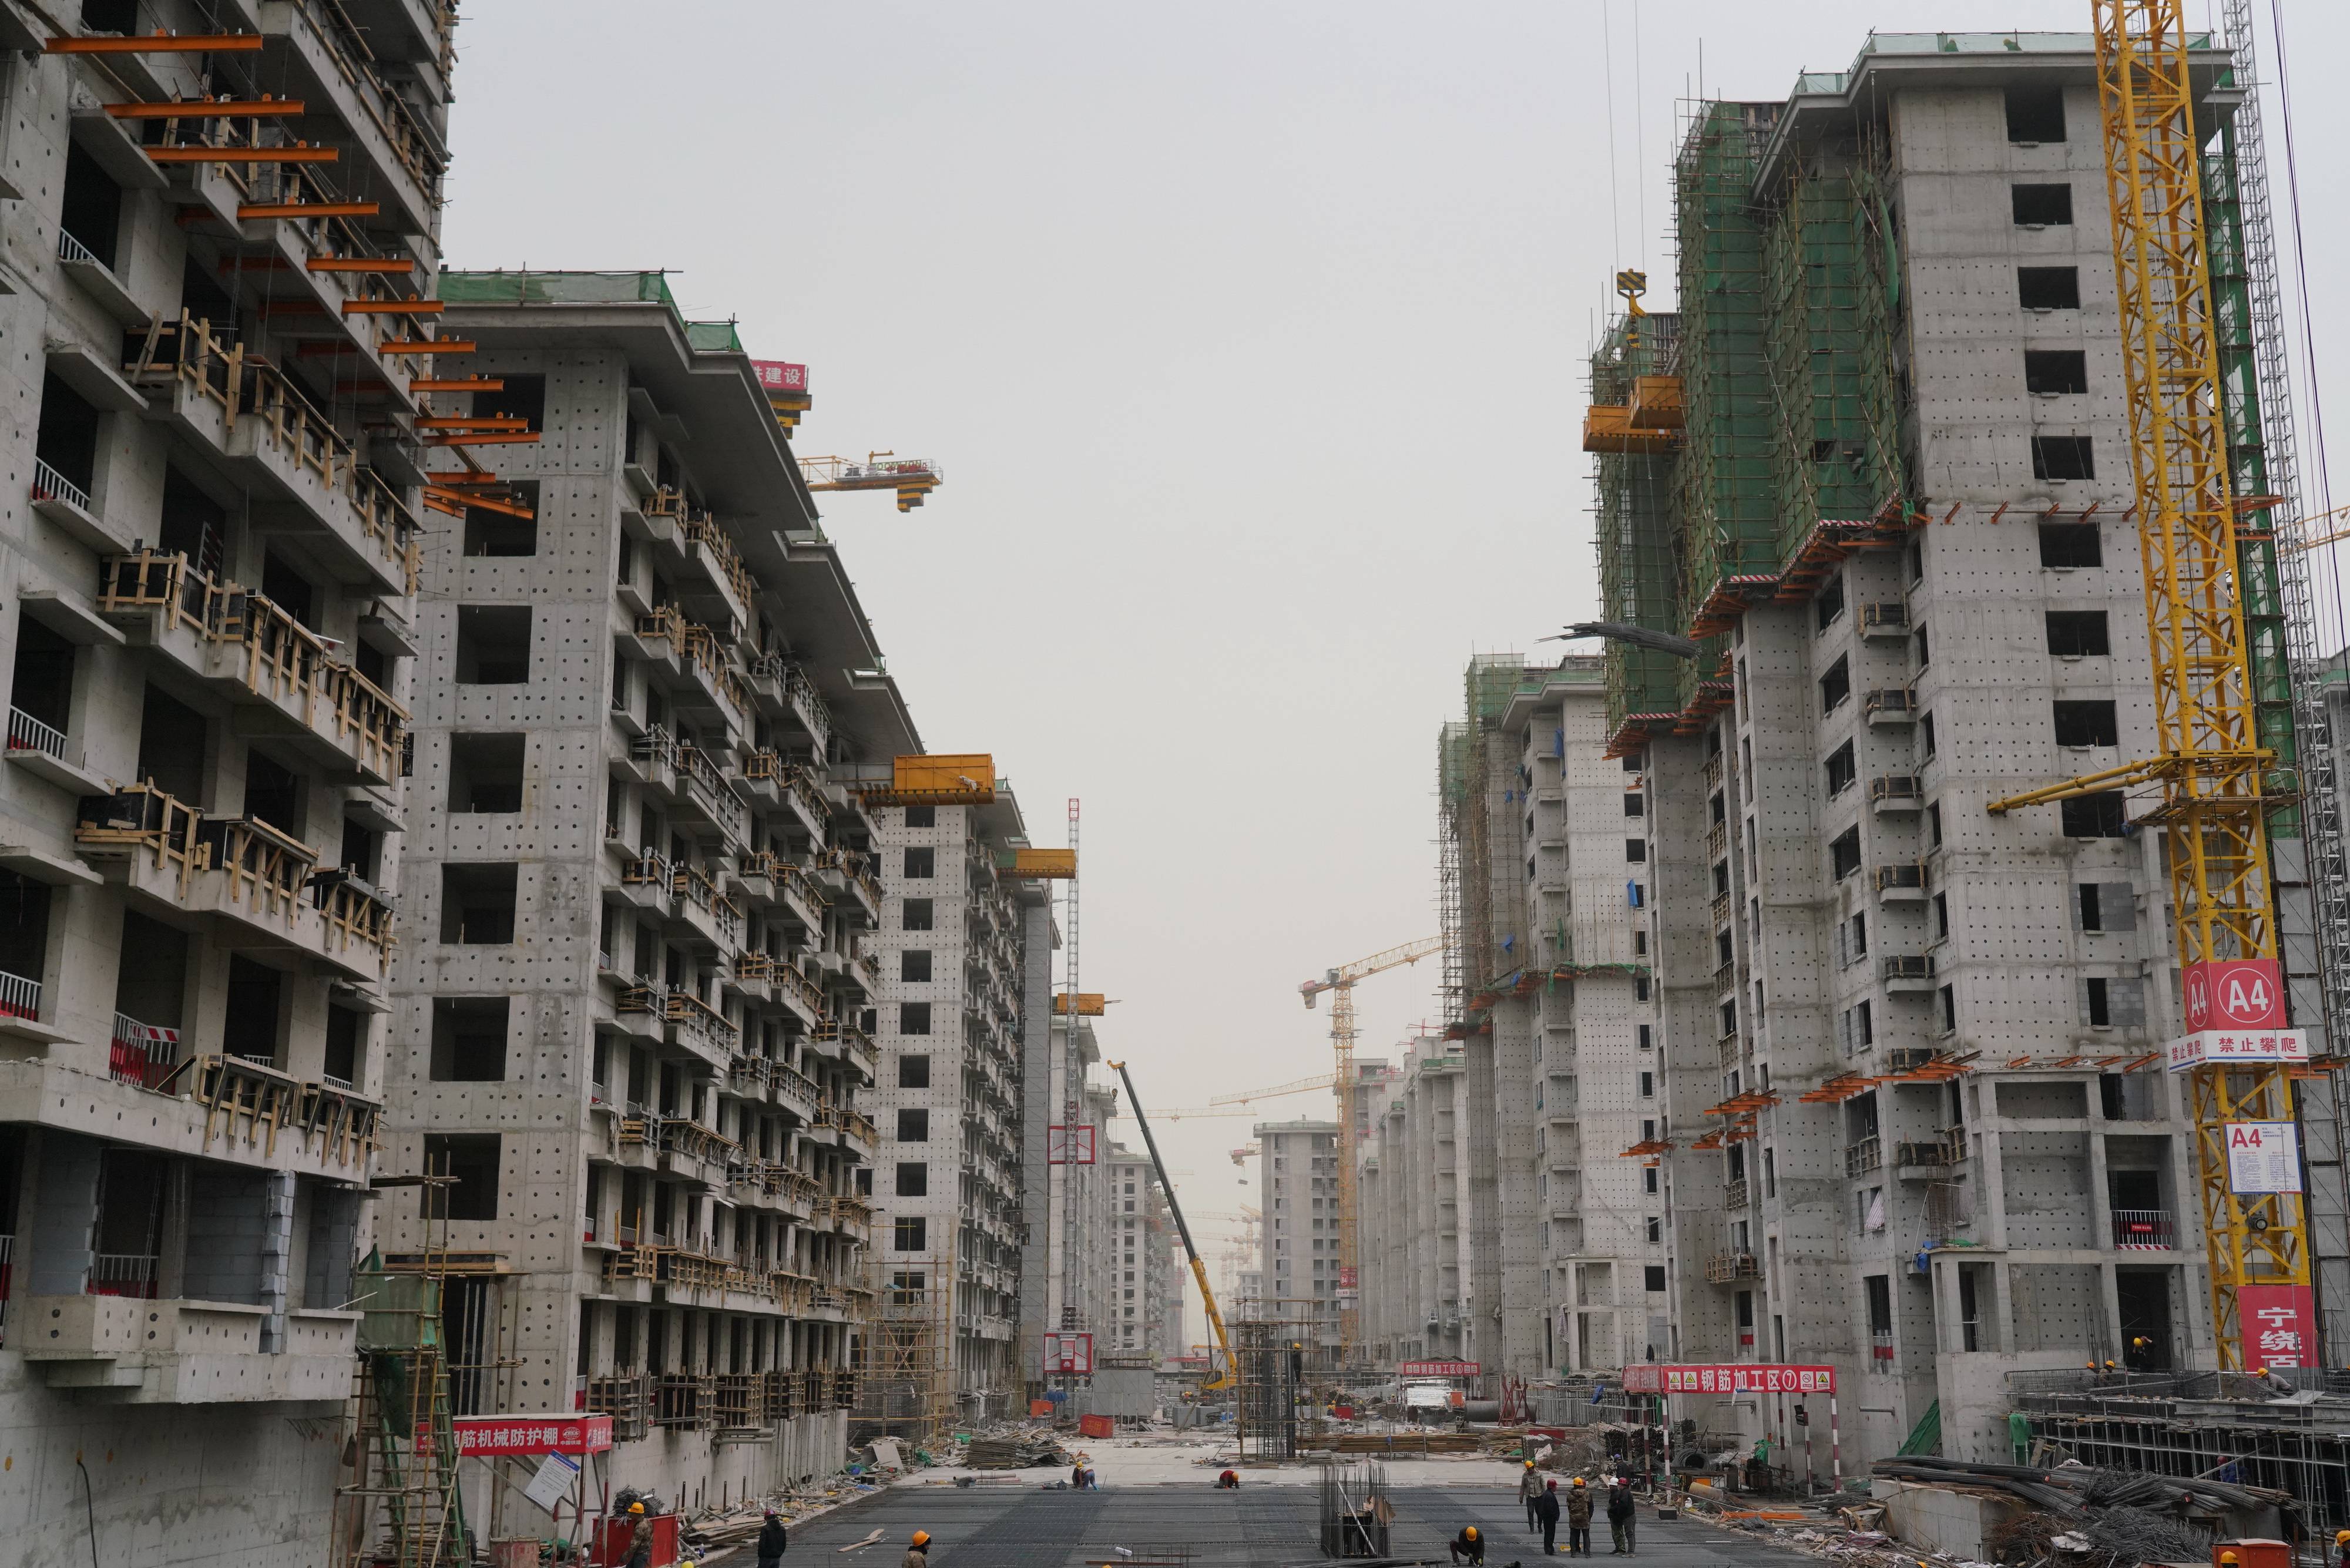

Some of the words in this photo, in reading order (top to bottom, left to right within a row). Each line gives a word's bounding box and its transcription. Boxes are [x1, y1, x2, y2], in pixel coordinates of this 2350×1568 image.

[2191, 982, 2207, 1018] A4
[2228, 979, 2268, 1013] A4
[2172, 1040, 2201, 1062] 禁止攀爬
[2218, 1037, 2297, 1053] 禁止攀爬
[2232, 1128, 2262, 1148] A4
